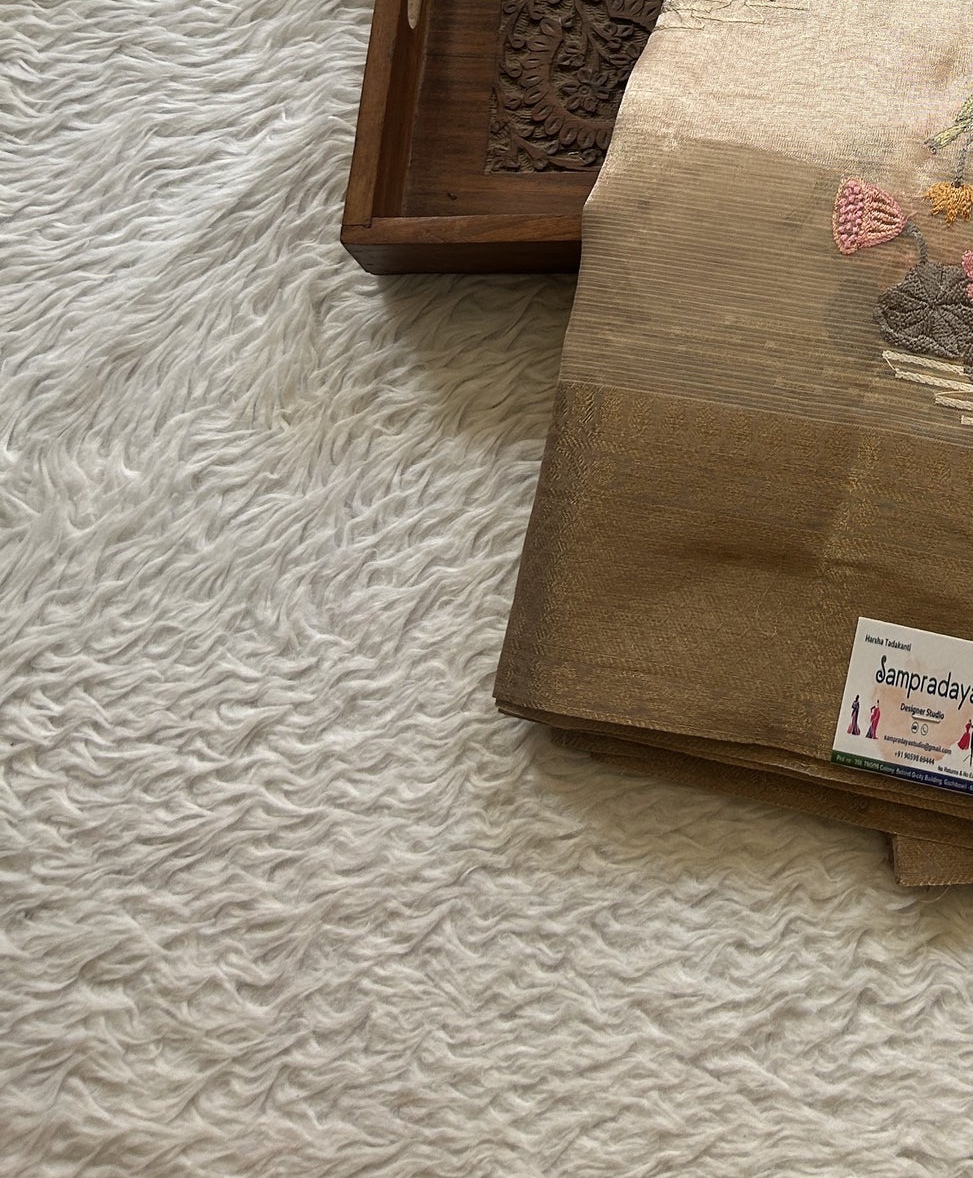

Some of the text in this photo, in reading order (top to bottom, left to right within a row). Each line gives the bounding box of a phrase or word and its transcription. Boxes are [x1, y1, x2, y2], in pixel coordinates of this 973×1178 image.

[865, 634, 884, 646] Harsha
[900, 702, 945, 720] Designer Studio
[894, 750, 904, 758] +91
